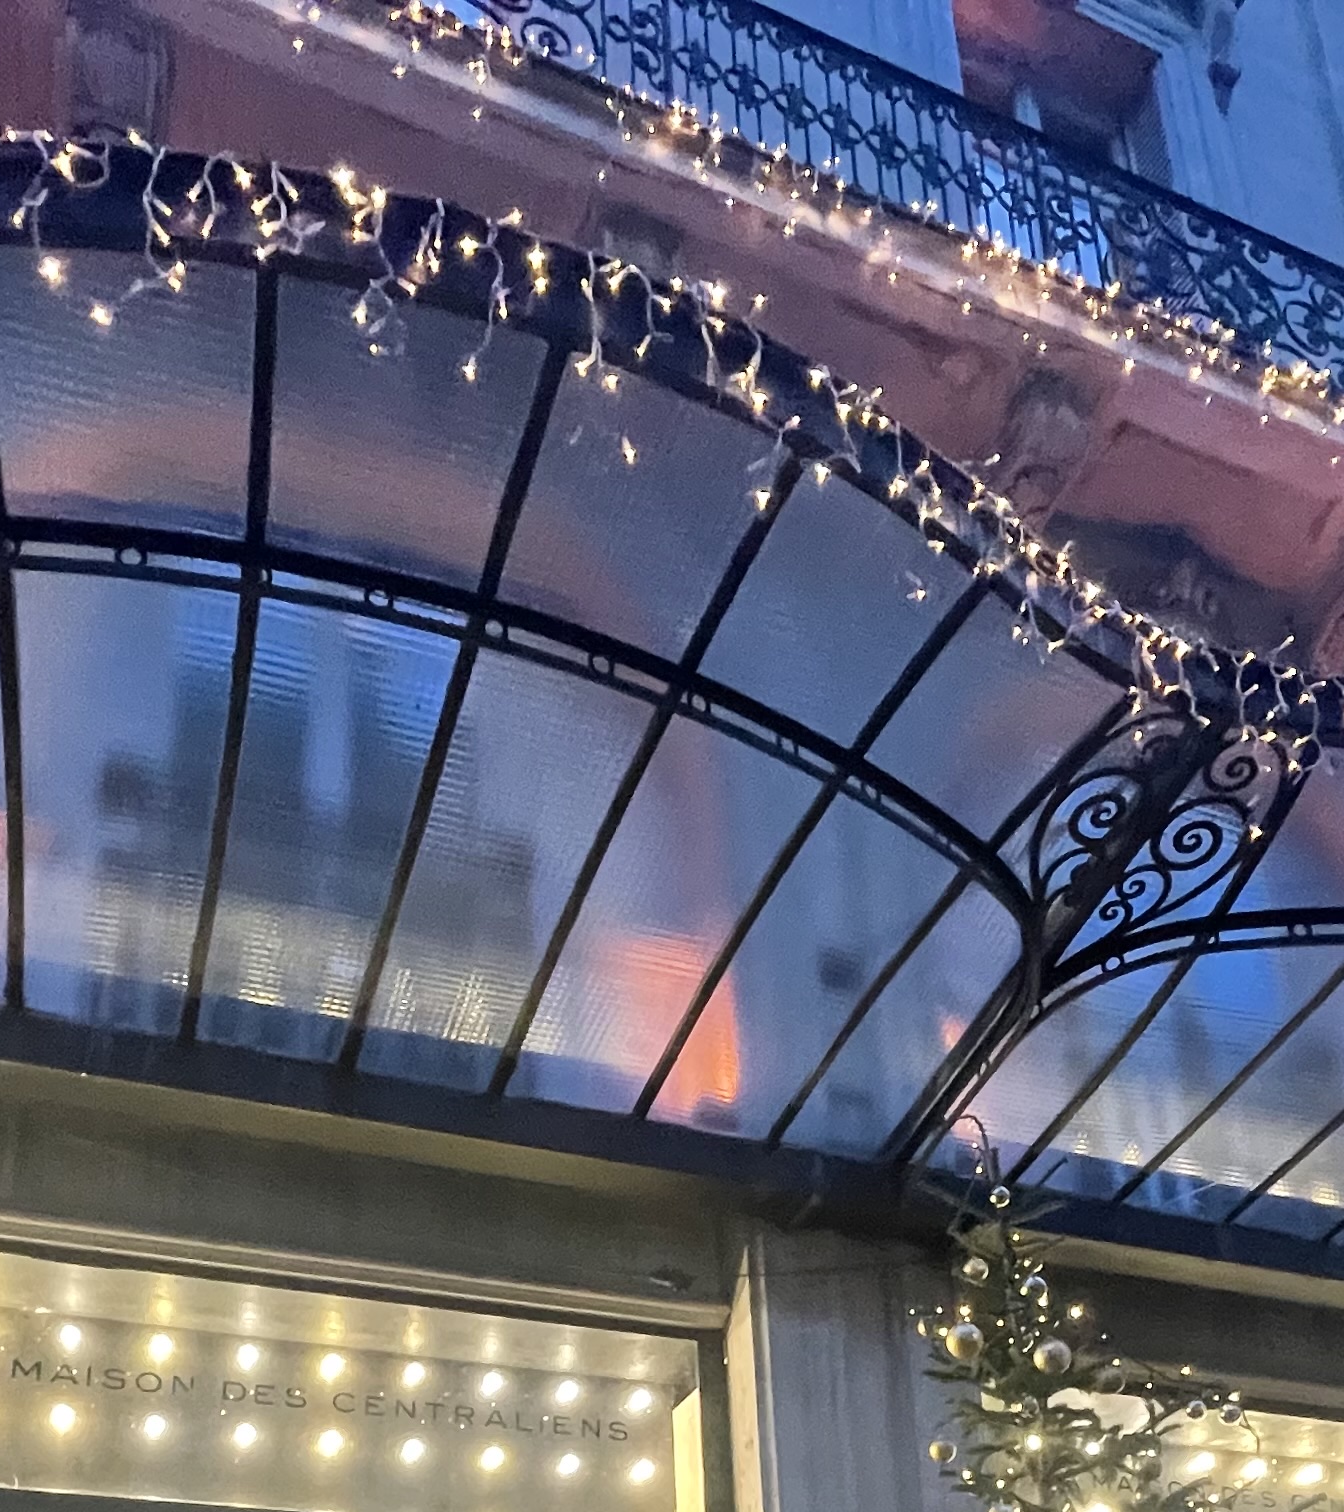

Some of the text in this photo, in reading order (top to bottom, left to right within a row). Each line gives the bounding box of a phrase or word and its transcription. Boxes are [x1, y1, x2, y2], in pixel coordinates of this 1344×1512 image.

[10, 1356, 195, 1394] MAISON
[221, 1380, 308, 1409] DES
[331, 1391, 630, 1442] CENTRALIENS
